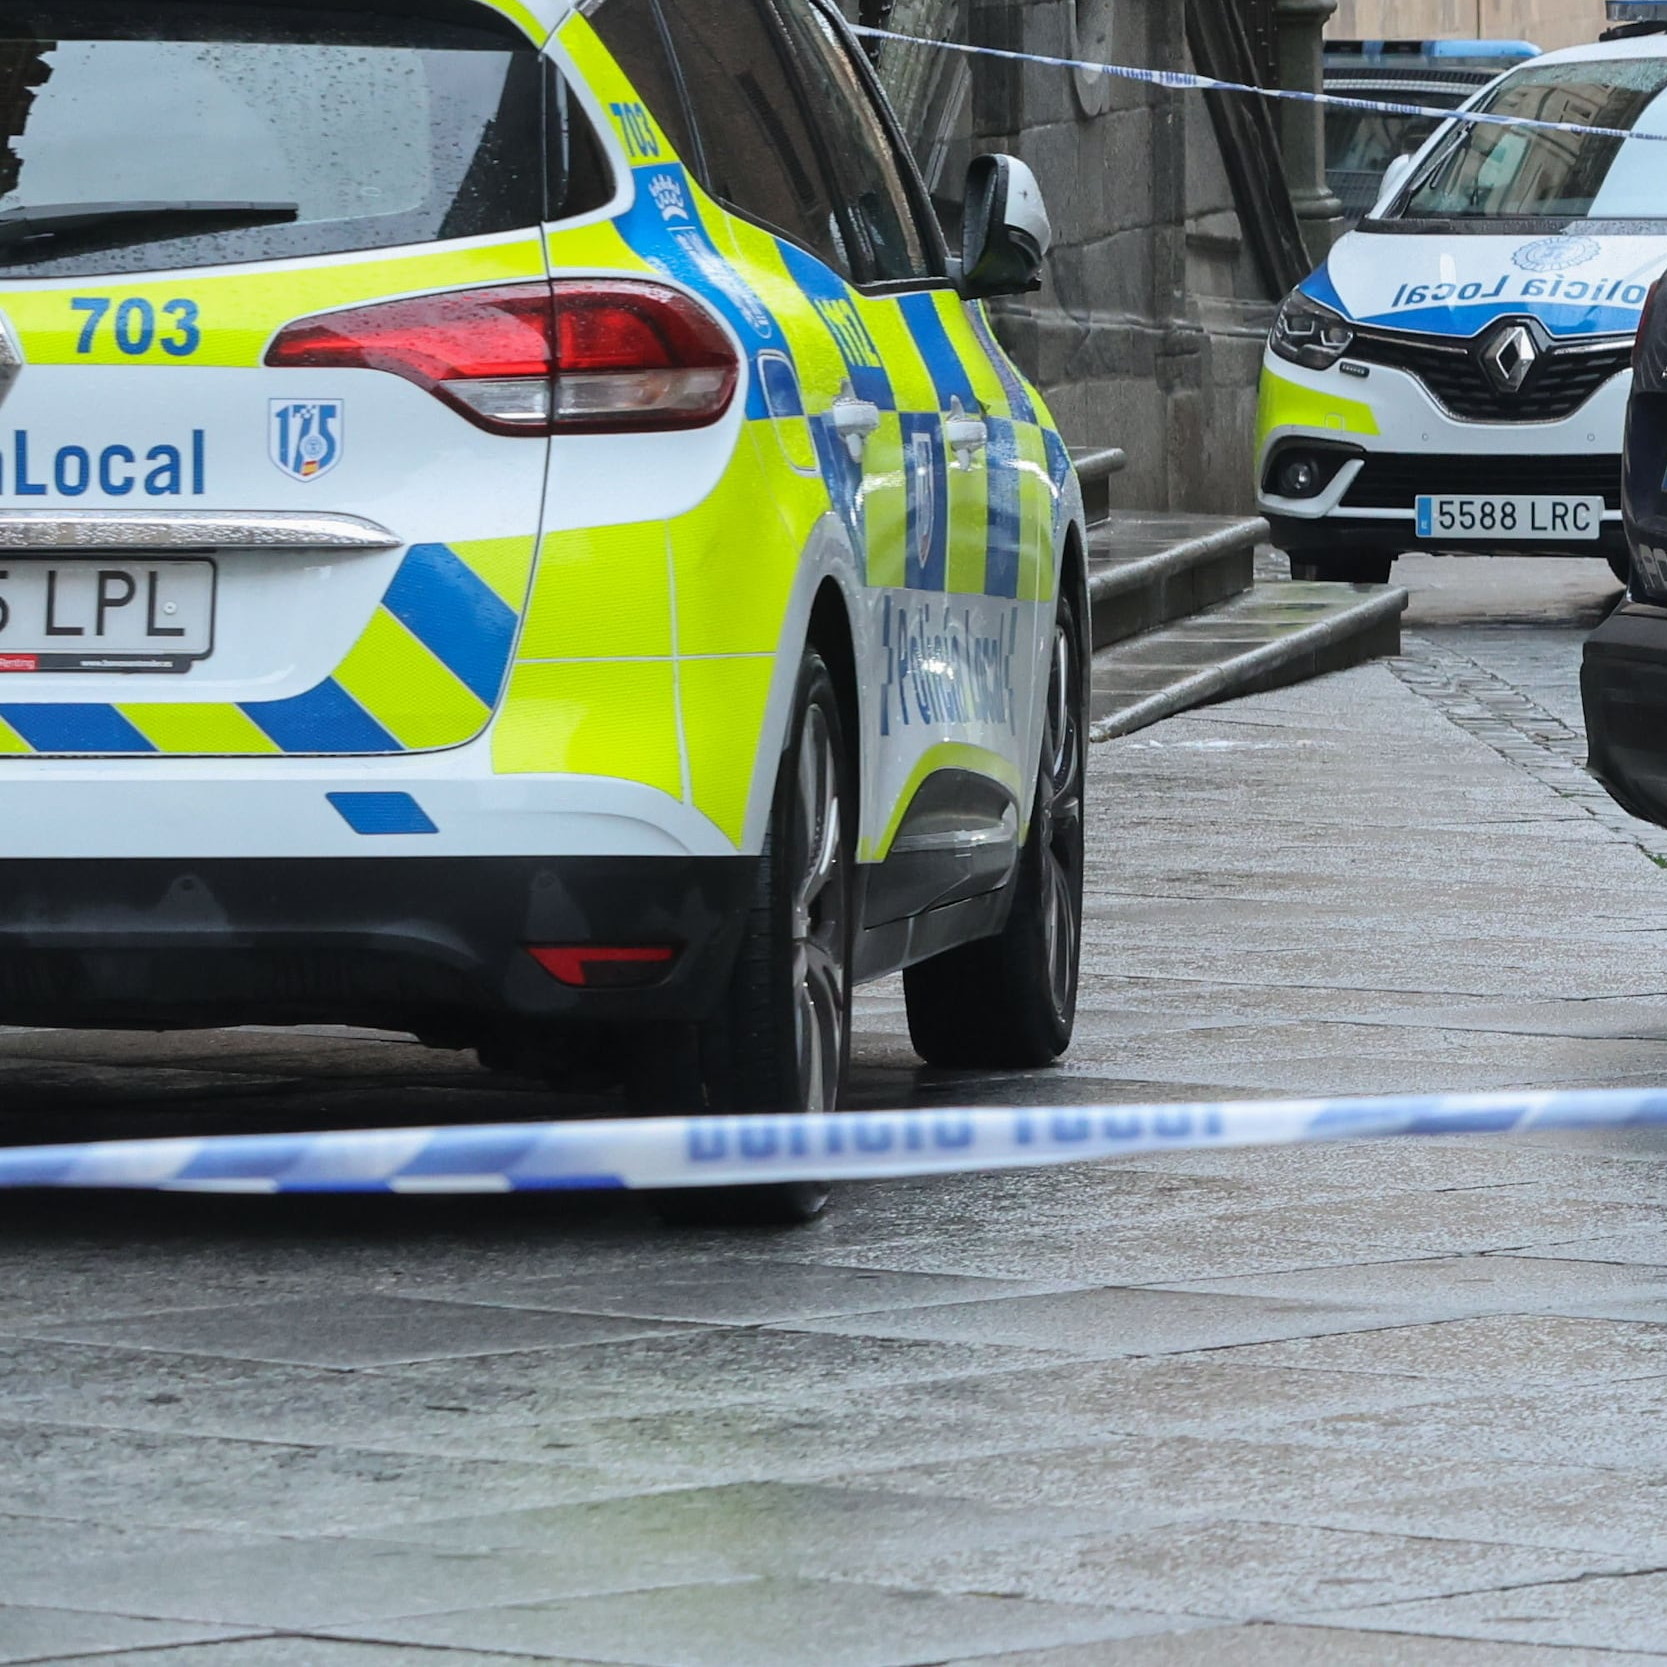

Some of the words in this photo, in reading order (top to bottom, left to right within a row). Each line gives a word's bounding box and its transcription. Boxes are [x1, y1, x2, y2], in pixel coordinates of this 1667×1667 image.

[610, 103, 660, 157] 703
[71, 297, 200, 356] 703
[0, 428, 205, 496] Local
[1438, 500, 1517, 531] 5588
[1531, 501, 1591, 532] LRC
[45, 570, 186, 637] LPL
